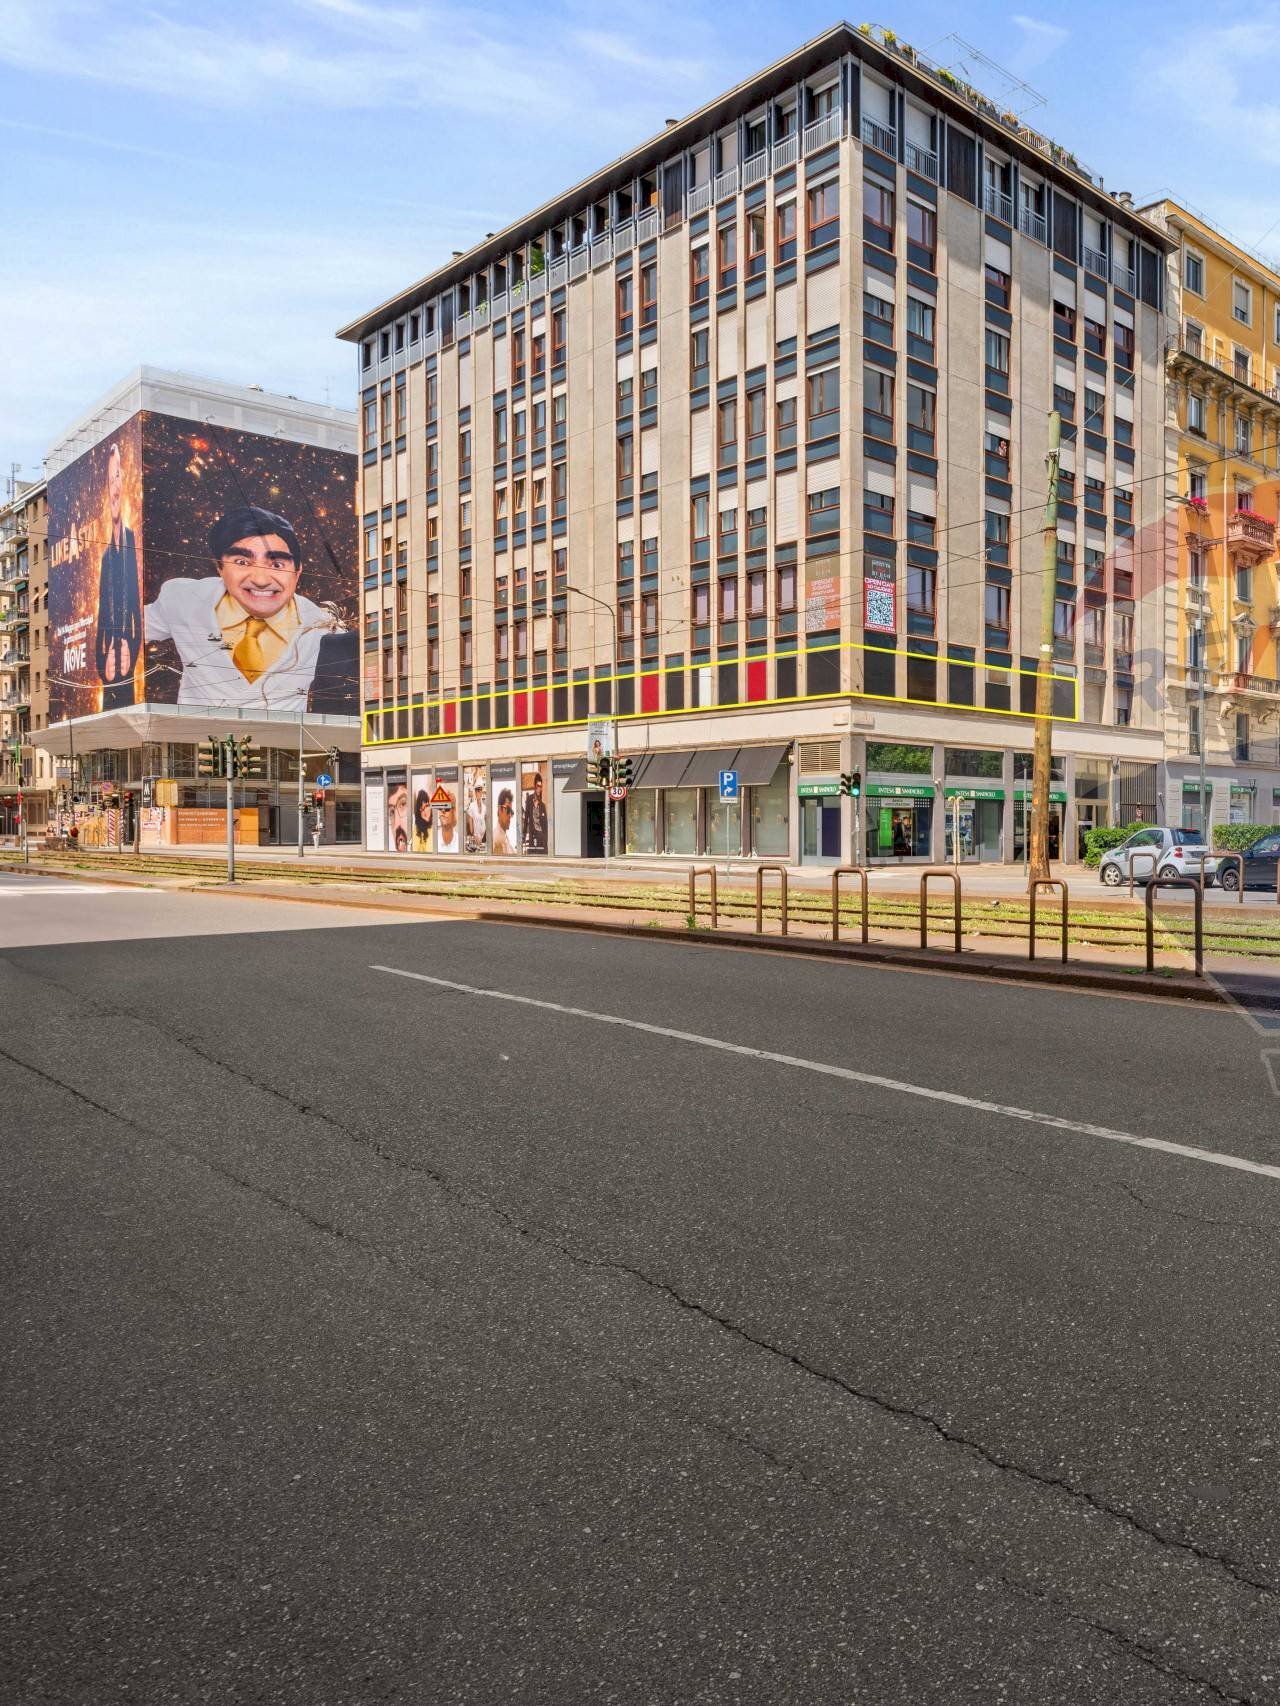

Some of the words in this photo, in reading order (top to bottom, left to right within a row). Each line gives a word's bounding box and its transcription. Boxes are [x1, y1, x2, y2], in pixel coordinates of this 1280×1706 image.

[63, 643, 87, 674] NOVE
[723, 772, 733, 785] P
[612, 787, 622, 796] 30
